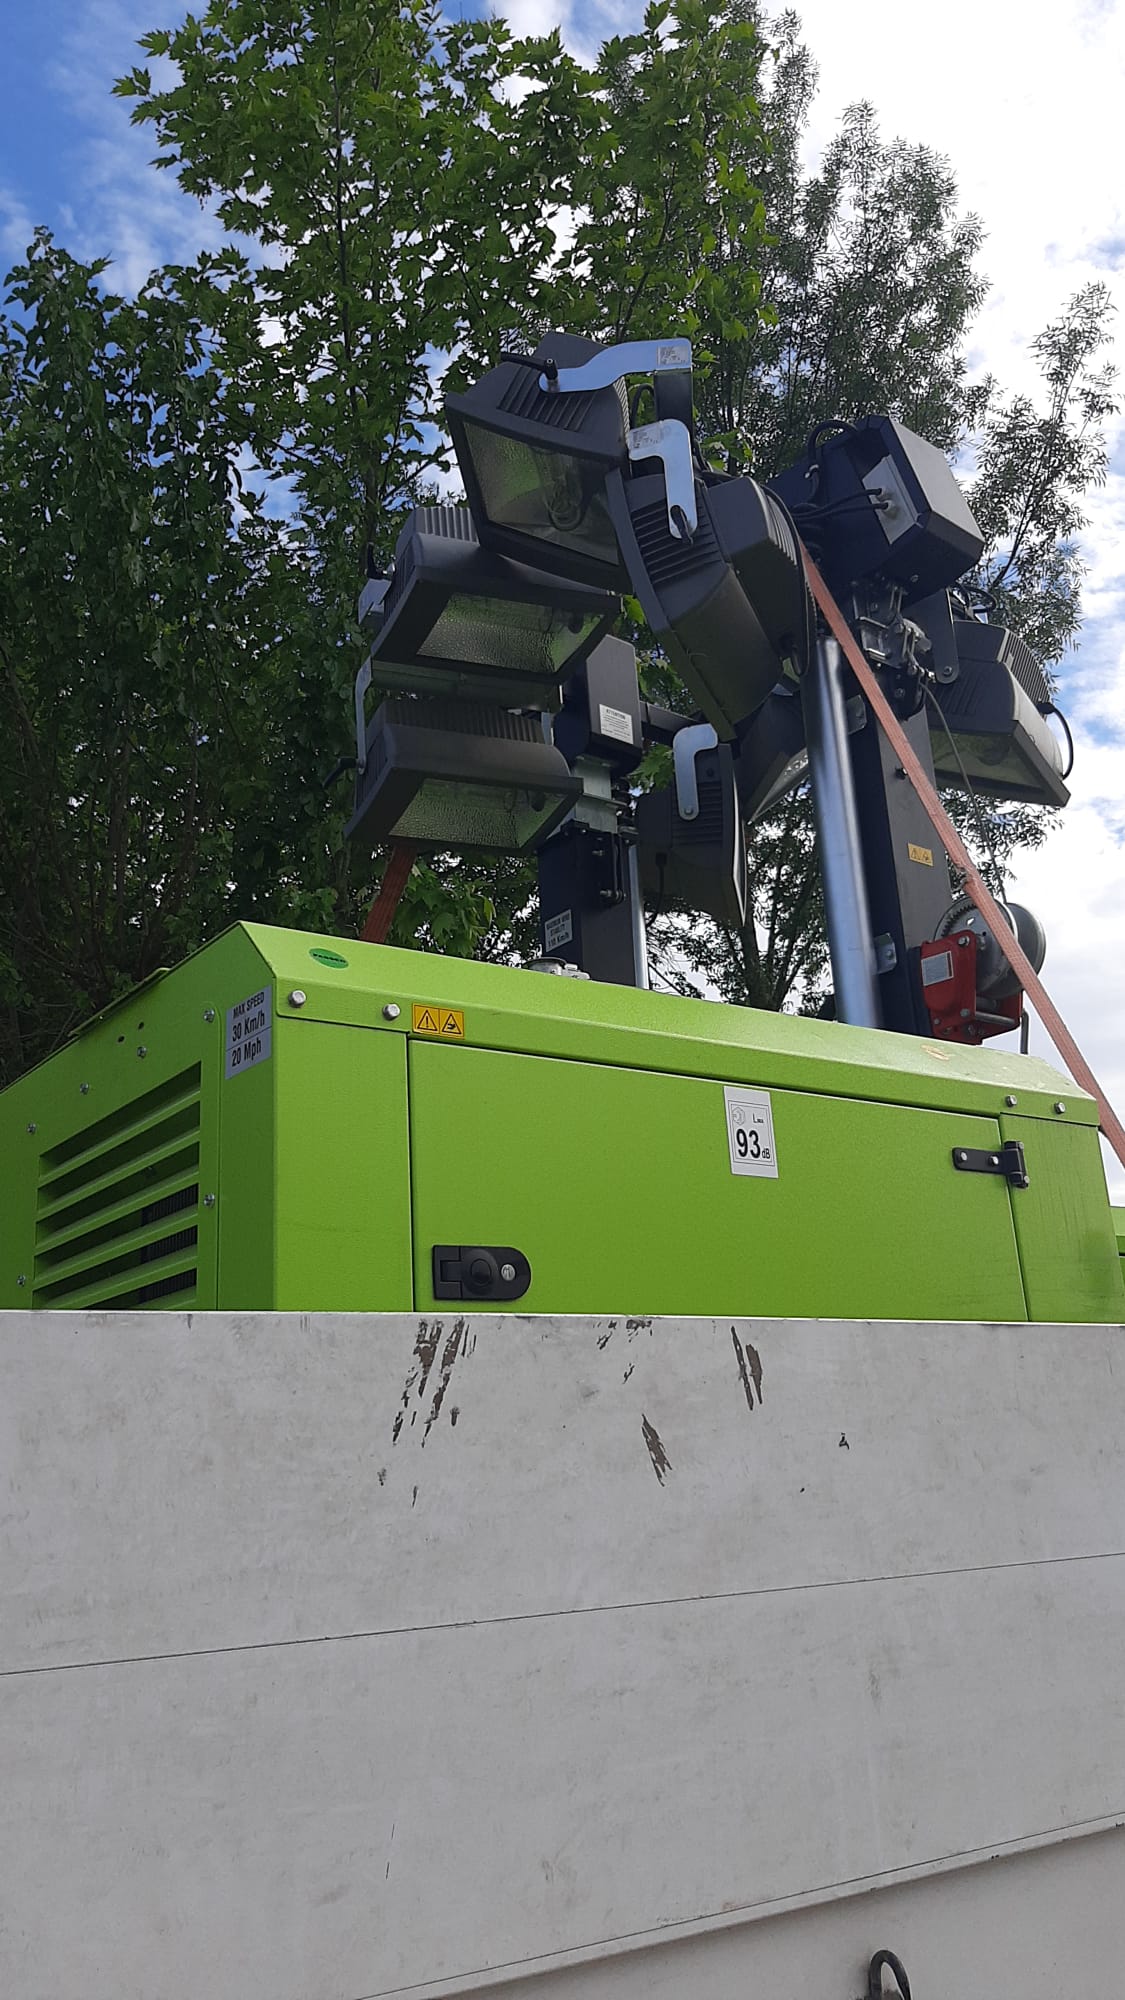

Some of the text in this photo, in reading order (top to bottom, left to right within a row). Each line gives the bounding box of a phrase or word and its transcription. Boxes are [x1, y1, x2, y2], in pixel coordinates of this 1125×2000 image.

[233, 991, 265, 1019] MAX SPEED
[232, 1009, 265, 1042] 30 Km/h
[231, 1037, 262, 1067] 20 Mph
[736, 1128, 771, 1160] 93 dB
